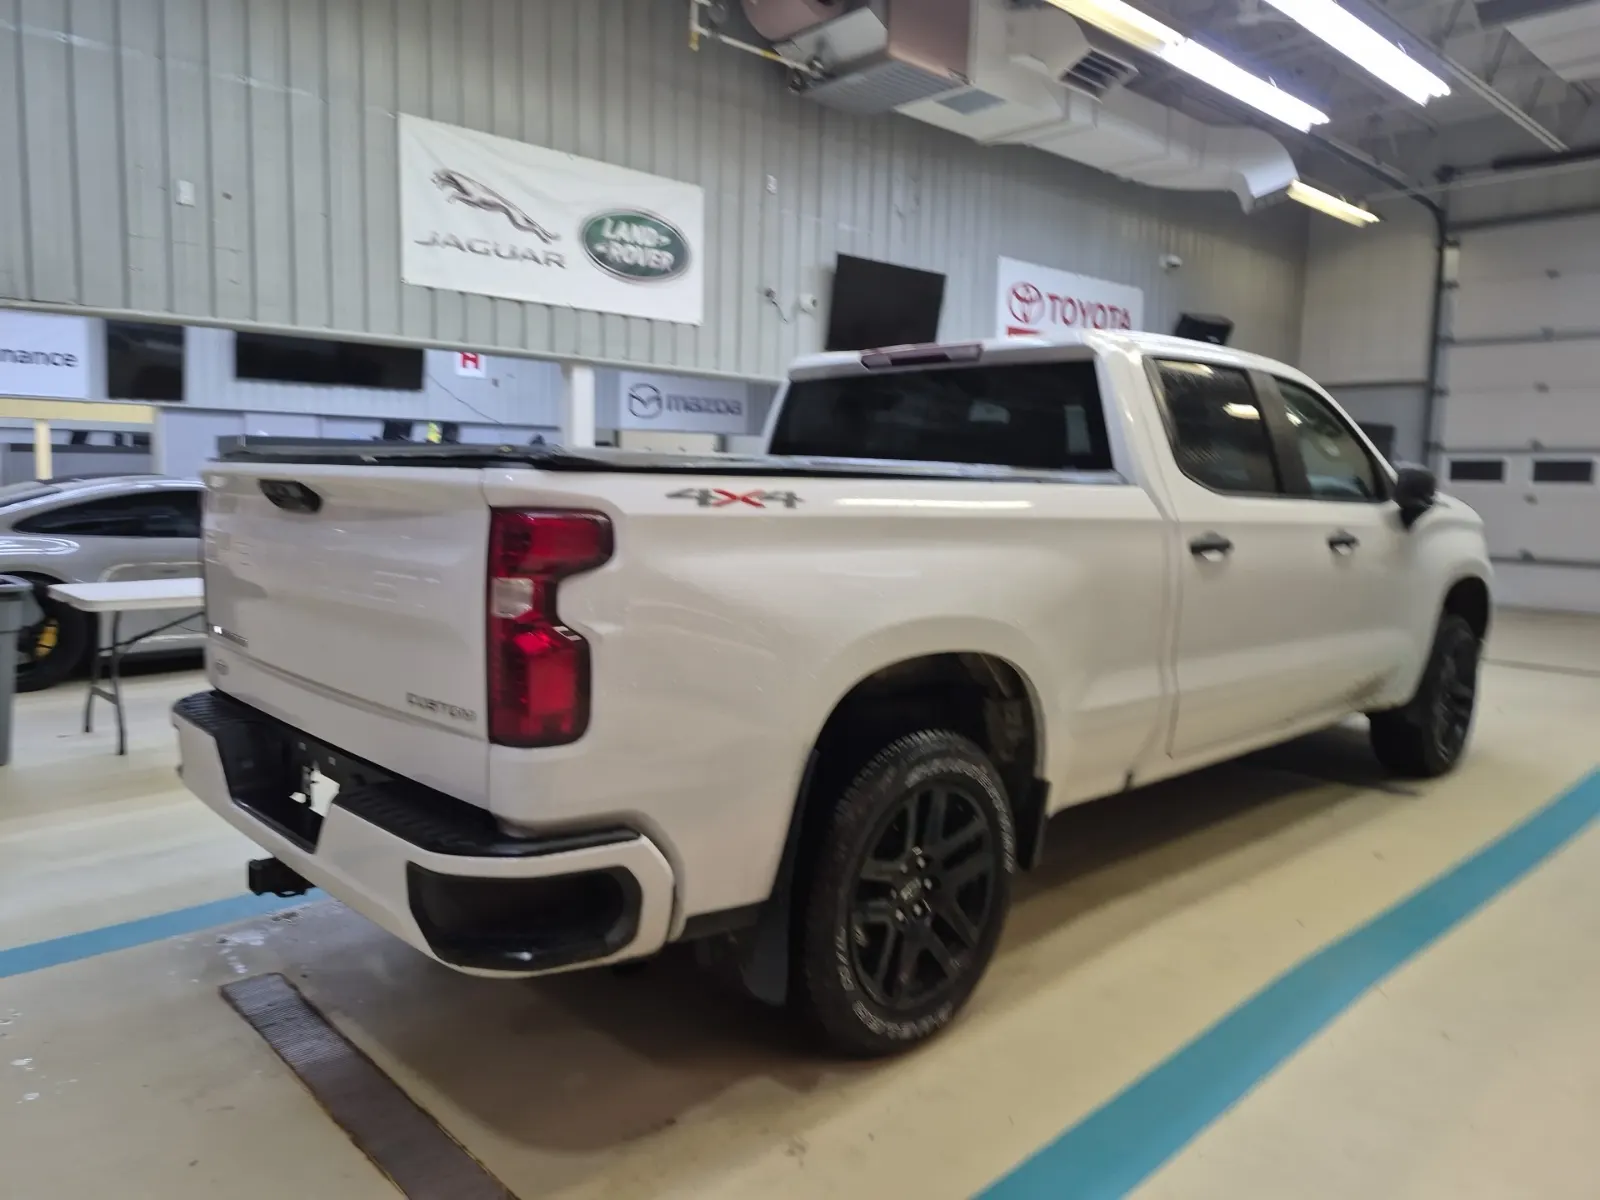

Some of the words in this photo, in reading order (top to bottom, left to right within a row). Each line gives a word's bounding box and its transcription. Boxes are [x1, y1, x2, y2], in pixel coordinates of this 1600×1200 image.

[414, 230, 568, 270] JAGUAR
[1047, 292, 1132, 330] TOYOTA
[665, 393, 743, 417] mazda
[405, 691, 478, 723] CUSTOM
